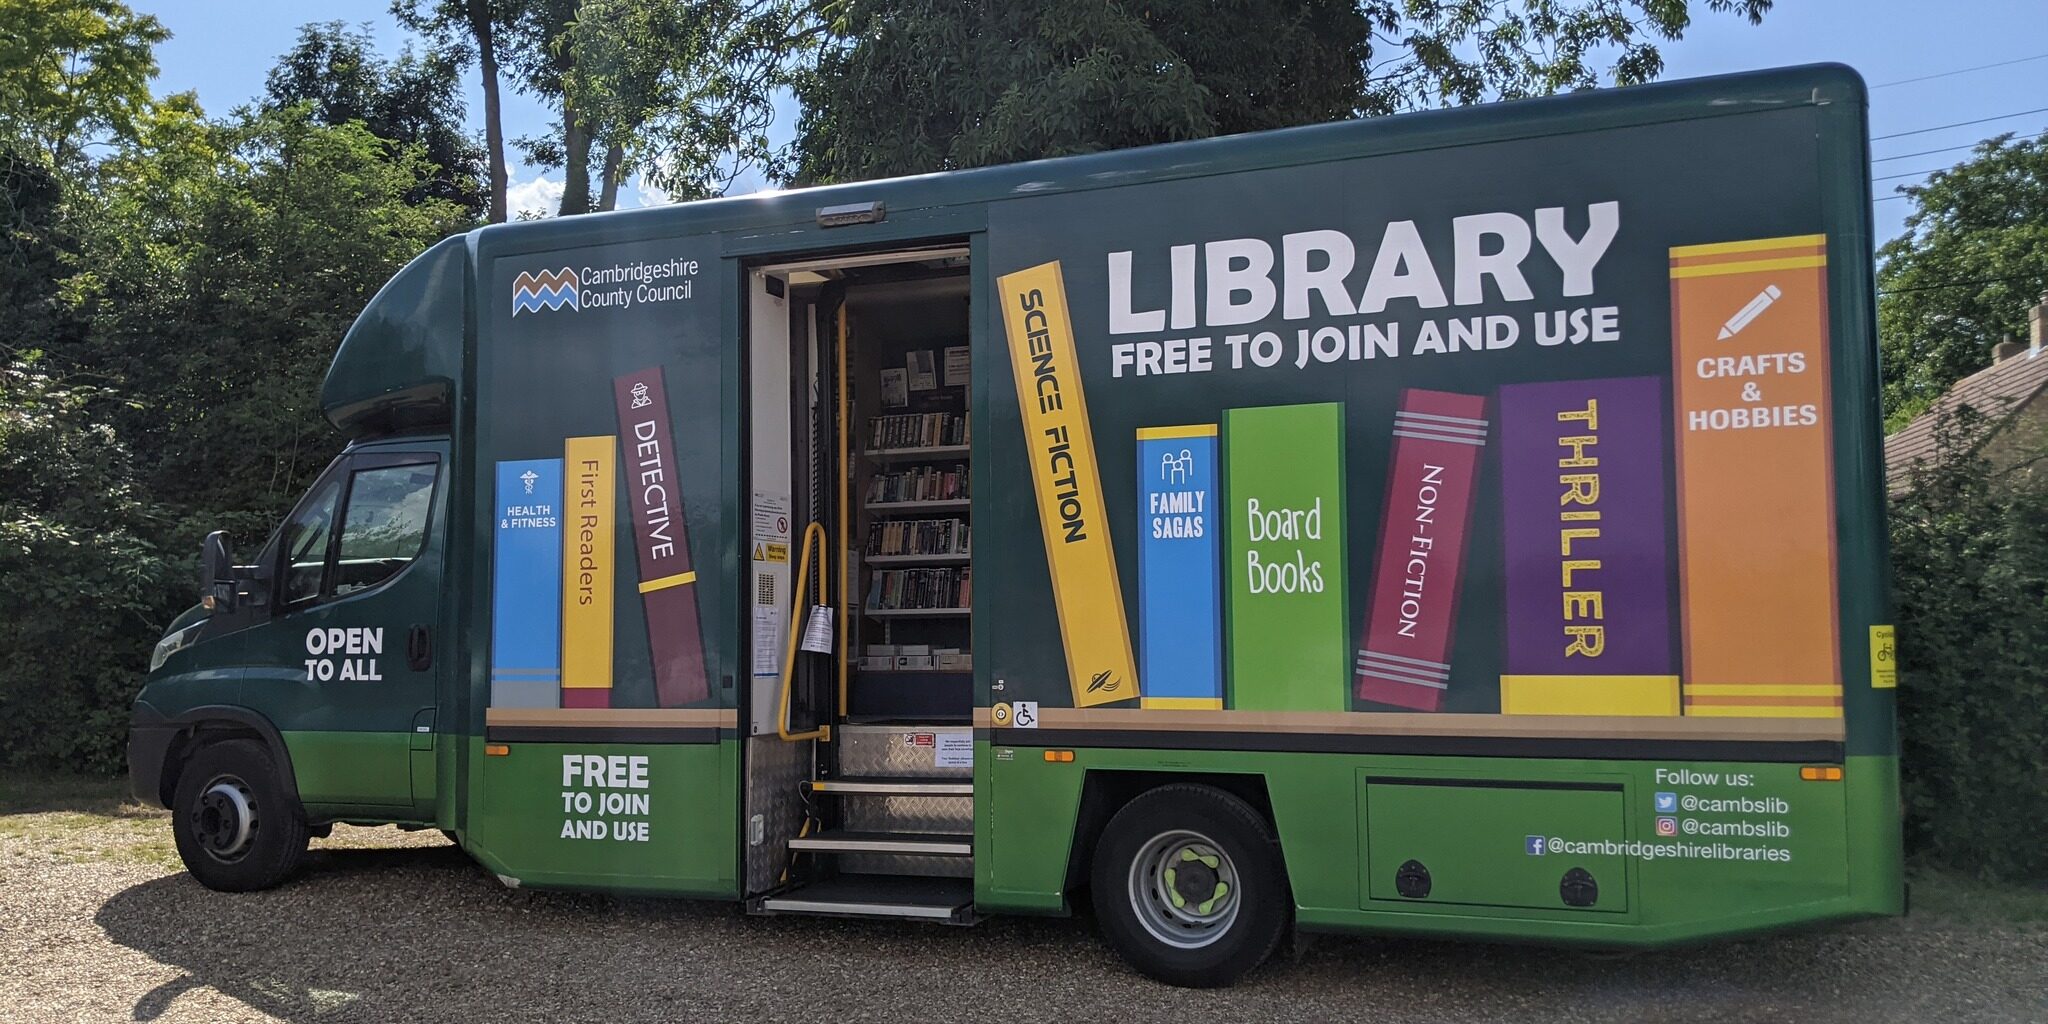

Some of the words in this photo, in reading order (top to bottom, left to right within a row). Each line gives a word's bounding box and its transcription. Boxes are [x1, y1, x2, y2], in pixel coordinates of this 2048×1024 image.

[581, 257, 699, 284] Cambridgeshire
[1107, 200, 1620, 335] LIBRARY
[582, 288, 632, 308] County
[636, 279, 692, 303] Council
[1112, 337, 1212, 377] FREE
[1225, 332, 1282, 368] TO
[1295, 322, 1399, 370] JOIN
[1413, 315, 1519, 355] AND
[1535, 307, 1619, 345] USE
[1697, 352, 1805, 378] CRAFTS
[1742, 382, 1761, 401] &
[1019, 288, 1064, 415] SCIENCE
[1044, 425, 1087, 544] FICTION
[1689, 405, 1817, 430] HOBBIES
[581, 461, 598, 507] First
[635, 421, 673, 559] DETECTIVE
[508, 505, 550, 516] HEALTH
[1151, 491, 1204, 513] FAMILY
[501, 519, 508, 528] &
[512, 514, 555, 528] FITNESS
[1153, 516, 1203, 538] SAGAS
[1248, 497, 1320, 541] Board
[1558, 399, 1604, 656] THRILLER
[580, 516, 597, 605] Readers
[1398, 464, 1444, 637] NON-FICTION
[1248, 550, 1323, 593] Books
[306, 628, 383, 654] OPEN
[305, 659, 333, 681] TO
[340, 659, 382, 680] ALL
[563, 755, 649, 788] FREE
[1656, 769, 1718, 785] Follow
[1726, 774, 1753, 786] us:
[562, 792, 592, 813] TO
[598, 793, 649, 816] JOIN
[1682, 795, 1788, 813] @cambslib
[561, 820, 607, 839] AND
[614, 822, 649, 841] USE
[1682, 819, 1789, 837] @cambslib
[1547, 837, 1791, 861] @cambridgeshirelibraries
